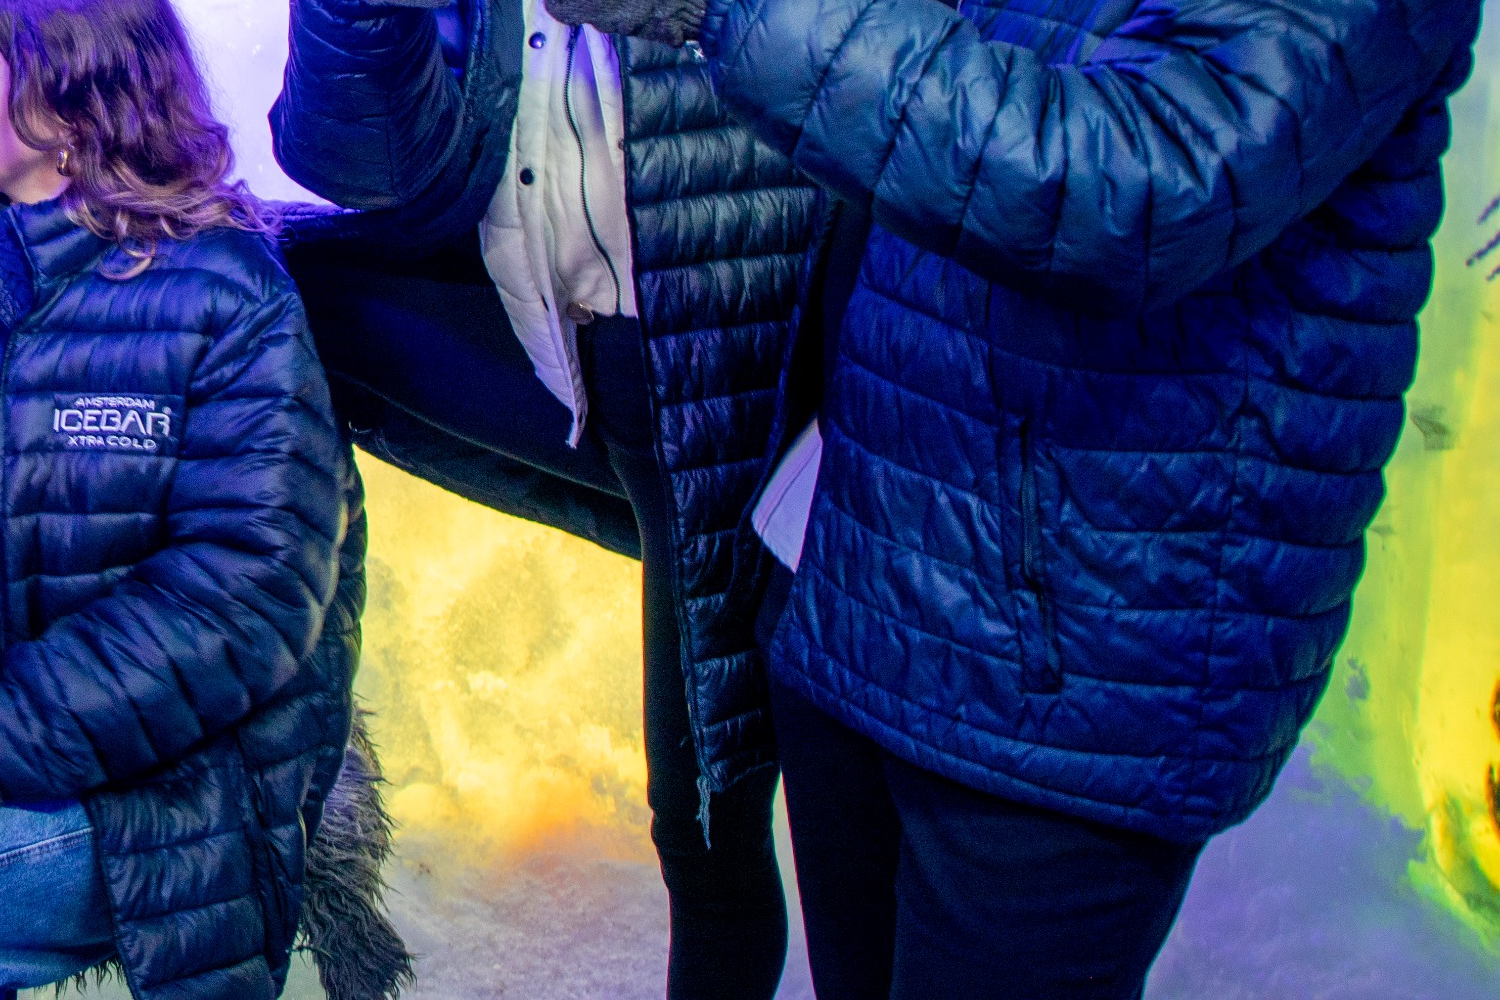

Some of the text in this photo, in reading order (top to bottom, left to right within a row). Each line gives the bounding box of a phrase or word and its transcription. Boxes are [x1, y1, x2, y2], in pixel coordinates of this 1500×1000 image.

[74, 397, 155, 411] AMSTERDAM
[53, 408, 171, 437] ICEBAR
[68, 435, 157, 450] XTRA COLD
